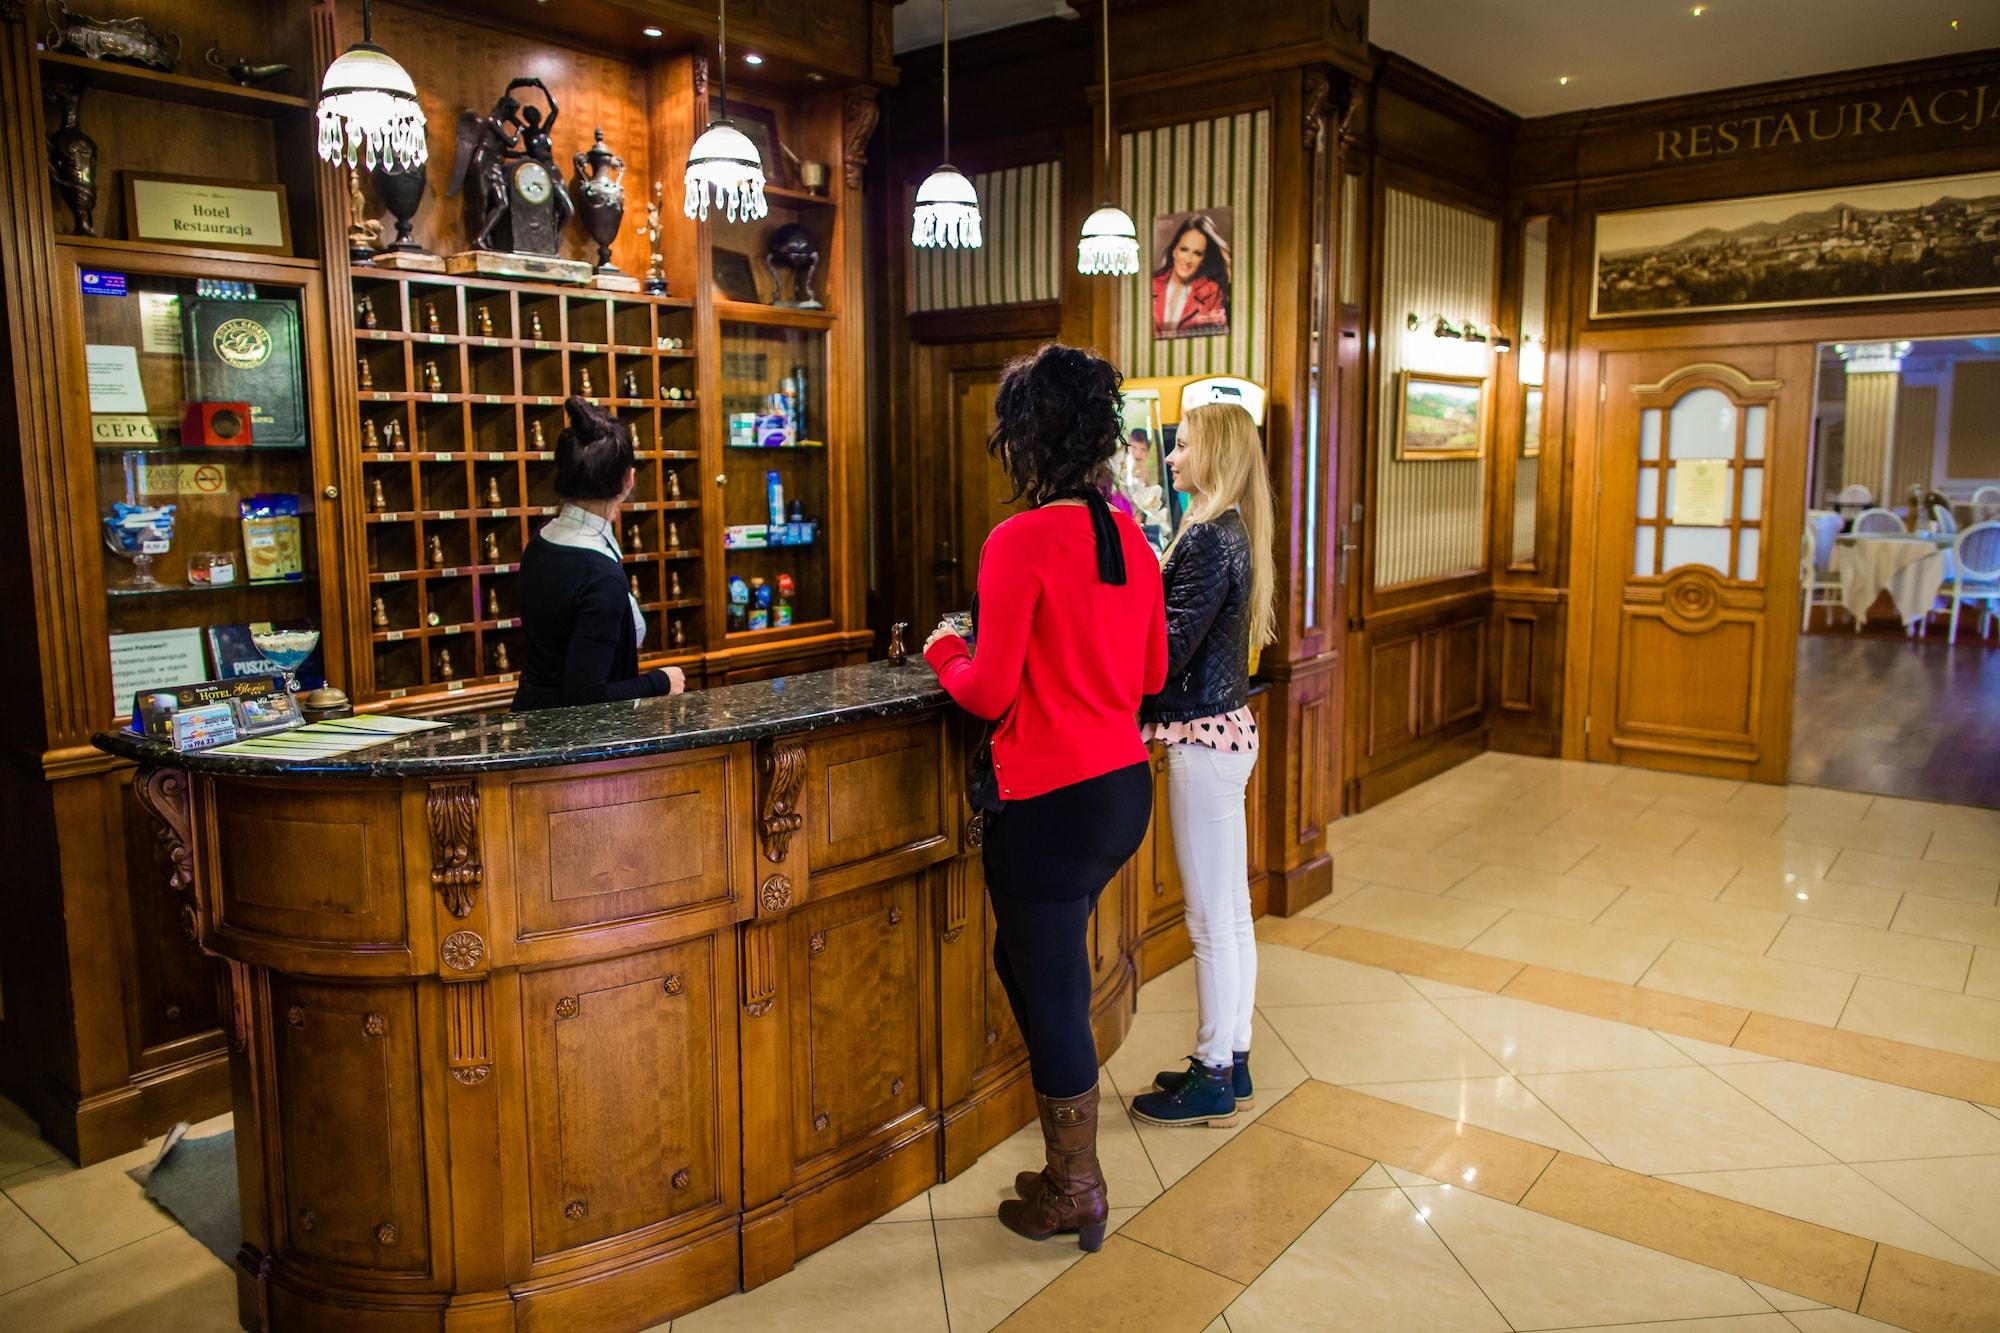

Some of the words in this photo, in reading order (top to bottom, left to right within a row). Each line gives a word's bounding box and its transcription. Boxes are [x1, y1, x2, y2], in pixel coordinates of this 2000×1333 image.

[193, 204, 230, 218] Hotel
[173, 218, 252, 237] Restauracja
[200, 690, 232, 701] HOTEL
[233, 682, 266, 697] Gloria
